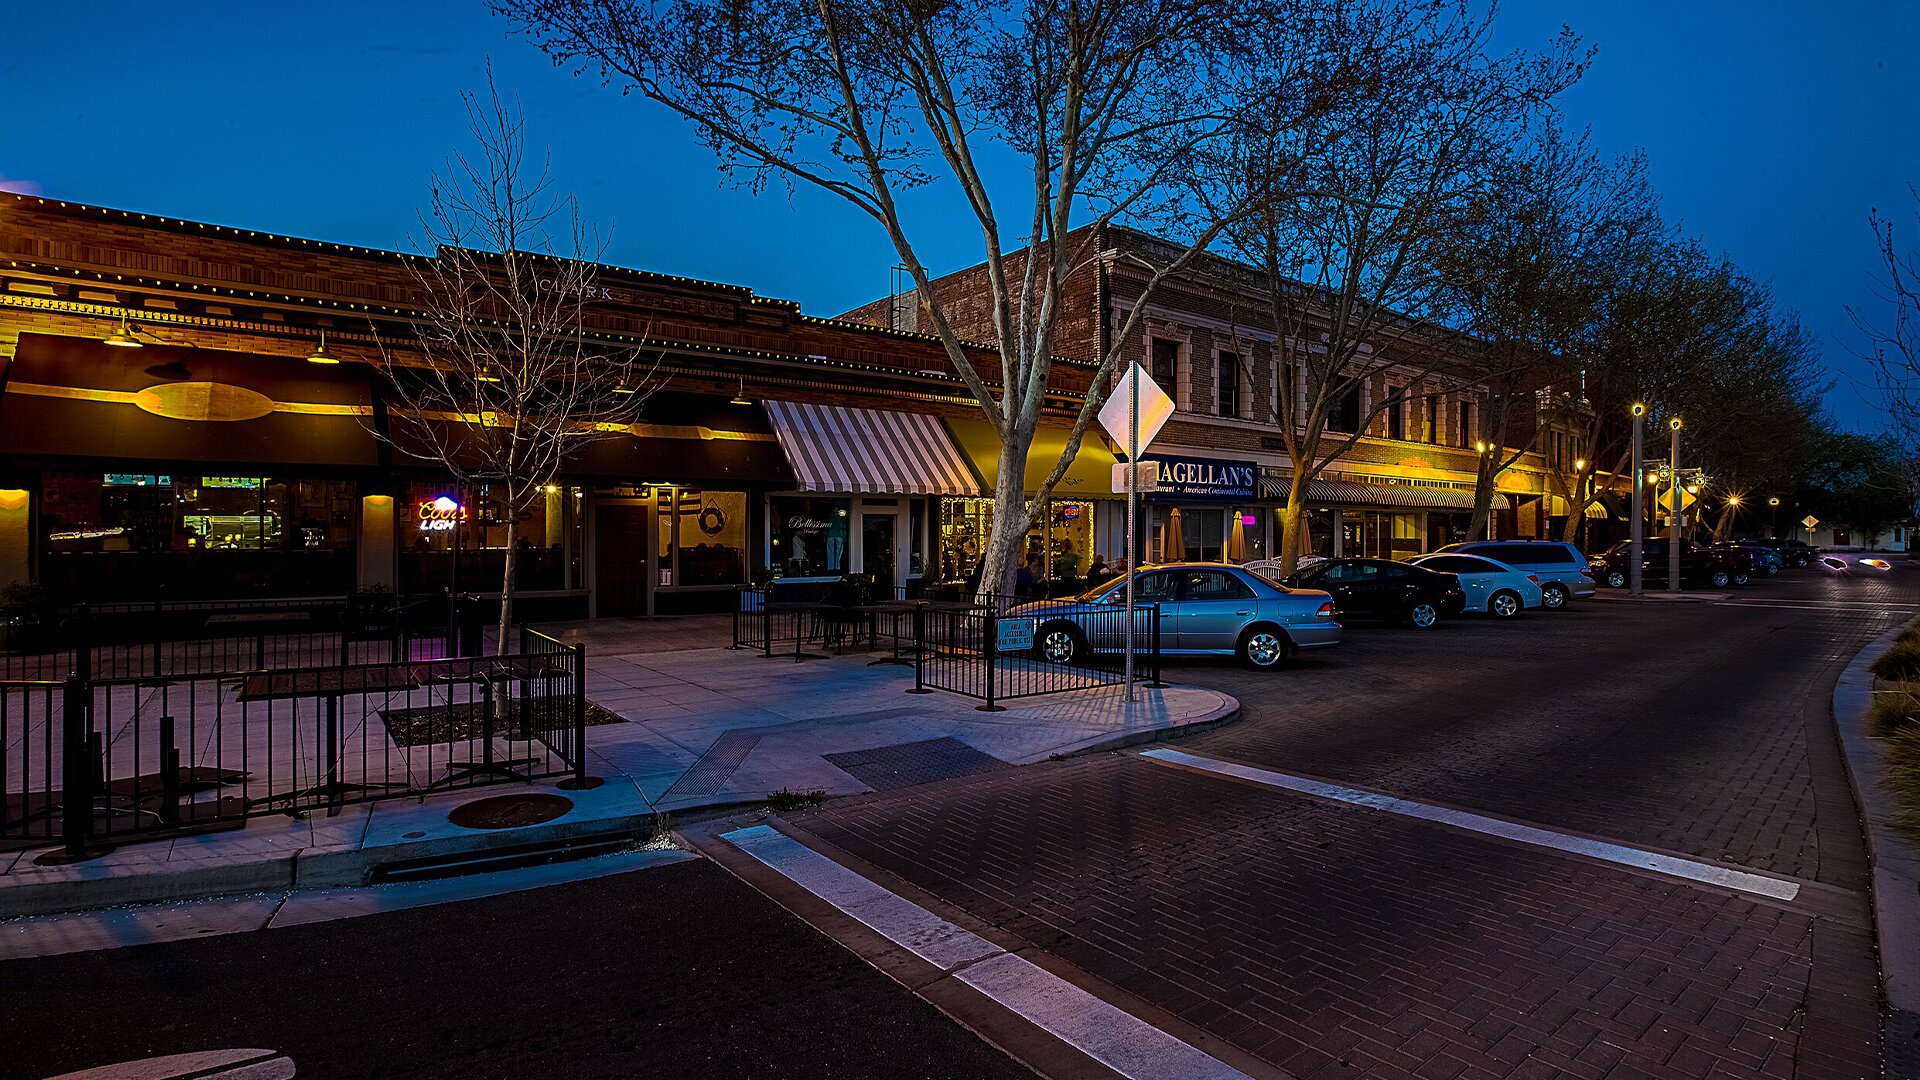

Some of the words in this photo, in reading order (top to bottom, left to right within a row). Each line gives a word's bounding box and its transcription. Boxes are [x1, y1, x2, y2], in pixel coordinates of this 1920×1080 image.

[539, 278, 613, 301] CLARK
[1183, 485, 1207, 494] American
[1207, 486, 1236, 496] Continental
[1236, 488, 1254, 497] Cuisine
[788, 515, 833, 529] Bellissima
